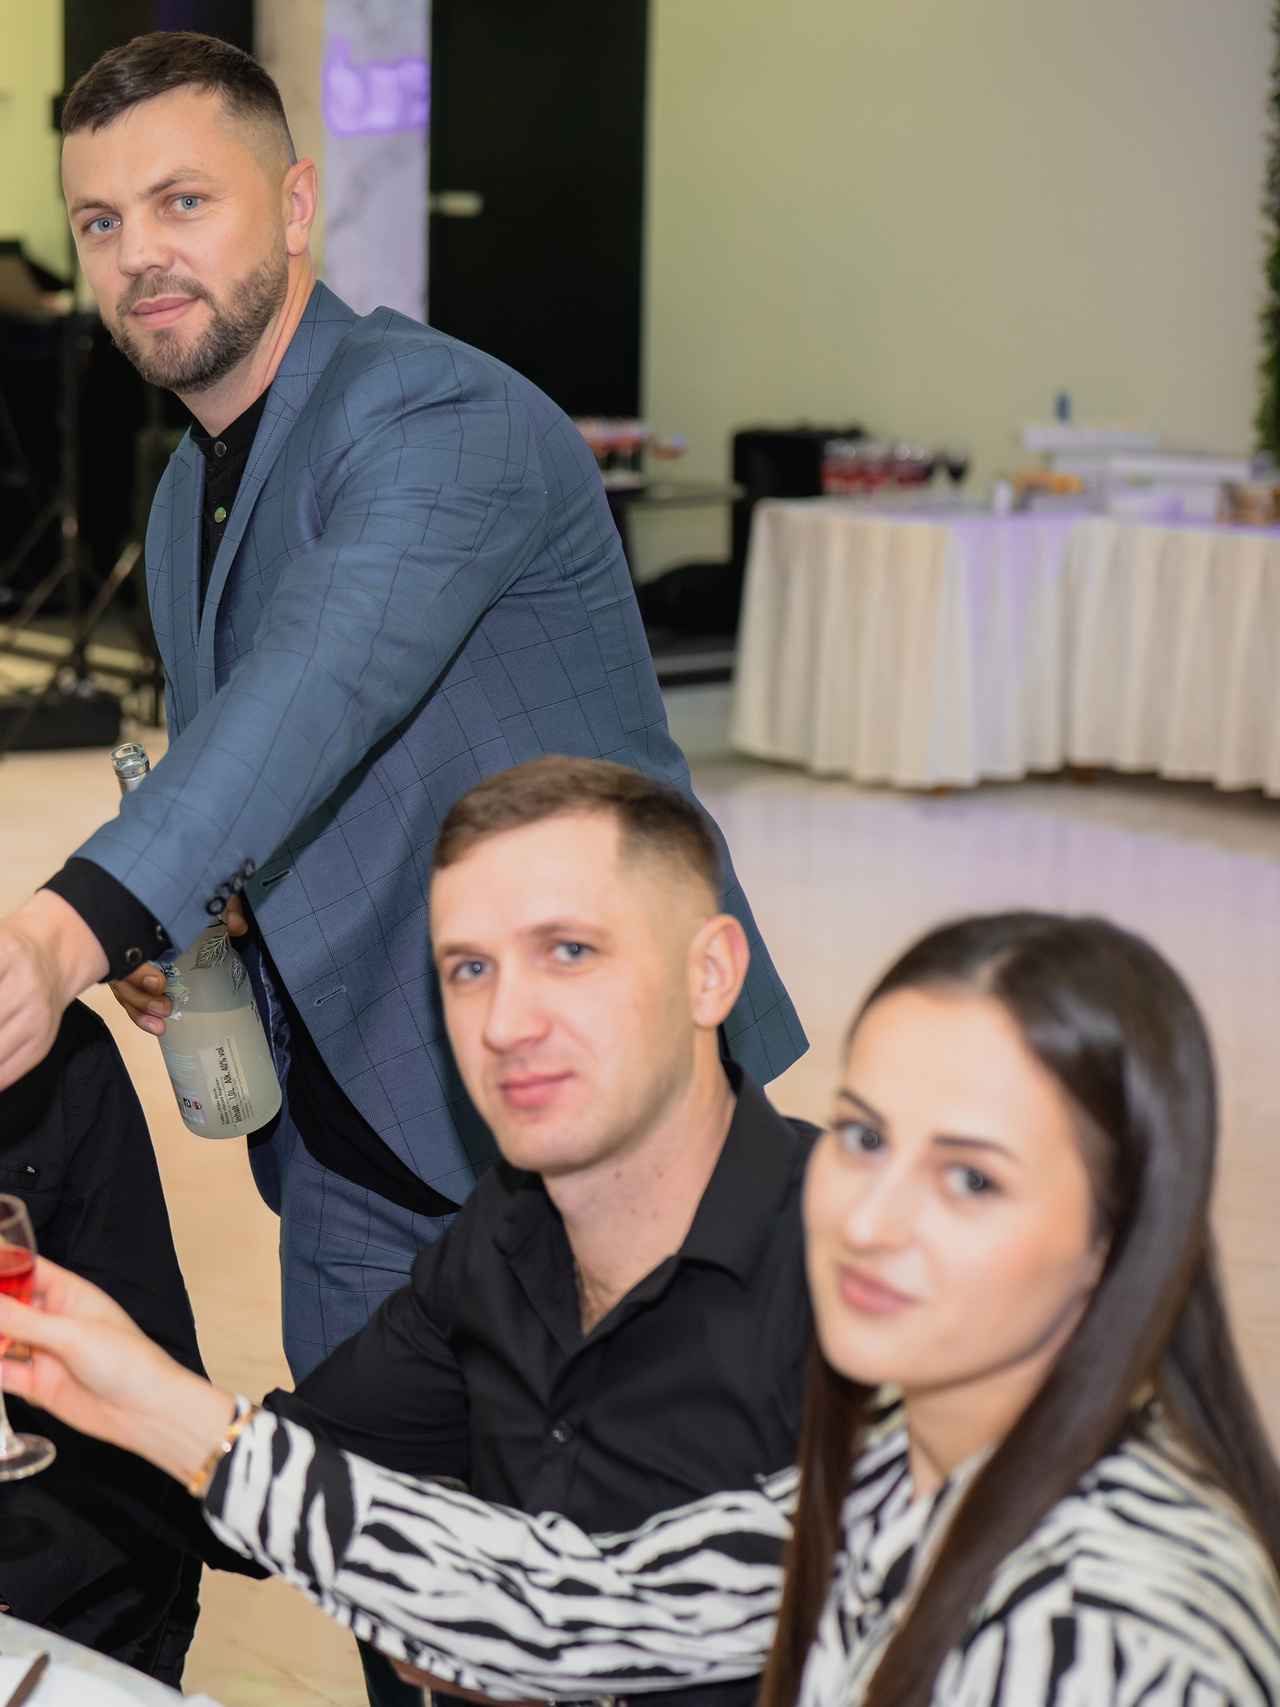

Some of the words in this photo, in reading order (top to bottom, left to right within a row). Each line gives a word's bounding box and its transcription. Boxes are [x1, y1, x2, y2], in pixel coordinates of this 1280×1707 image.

[216, 1046, 225, 1057] vol
[219, 1057, 228, 1071] 40%
[223, 1072, 232, 1084] Alk.
[232, 1104, 242, 1122] Inhalt
